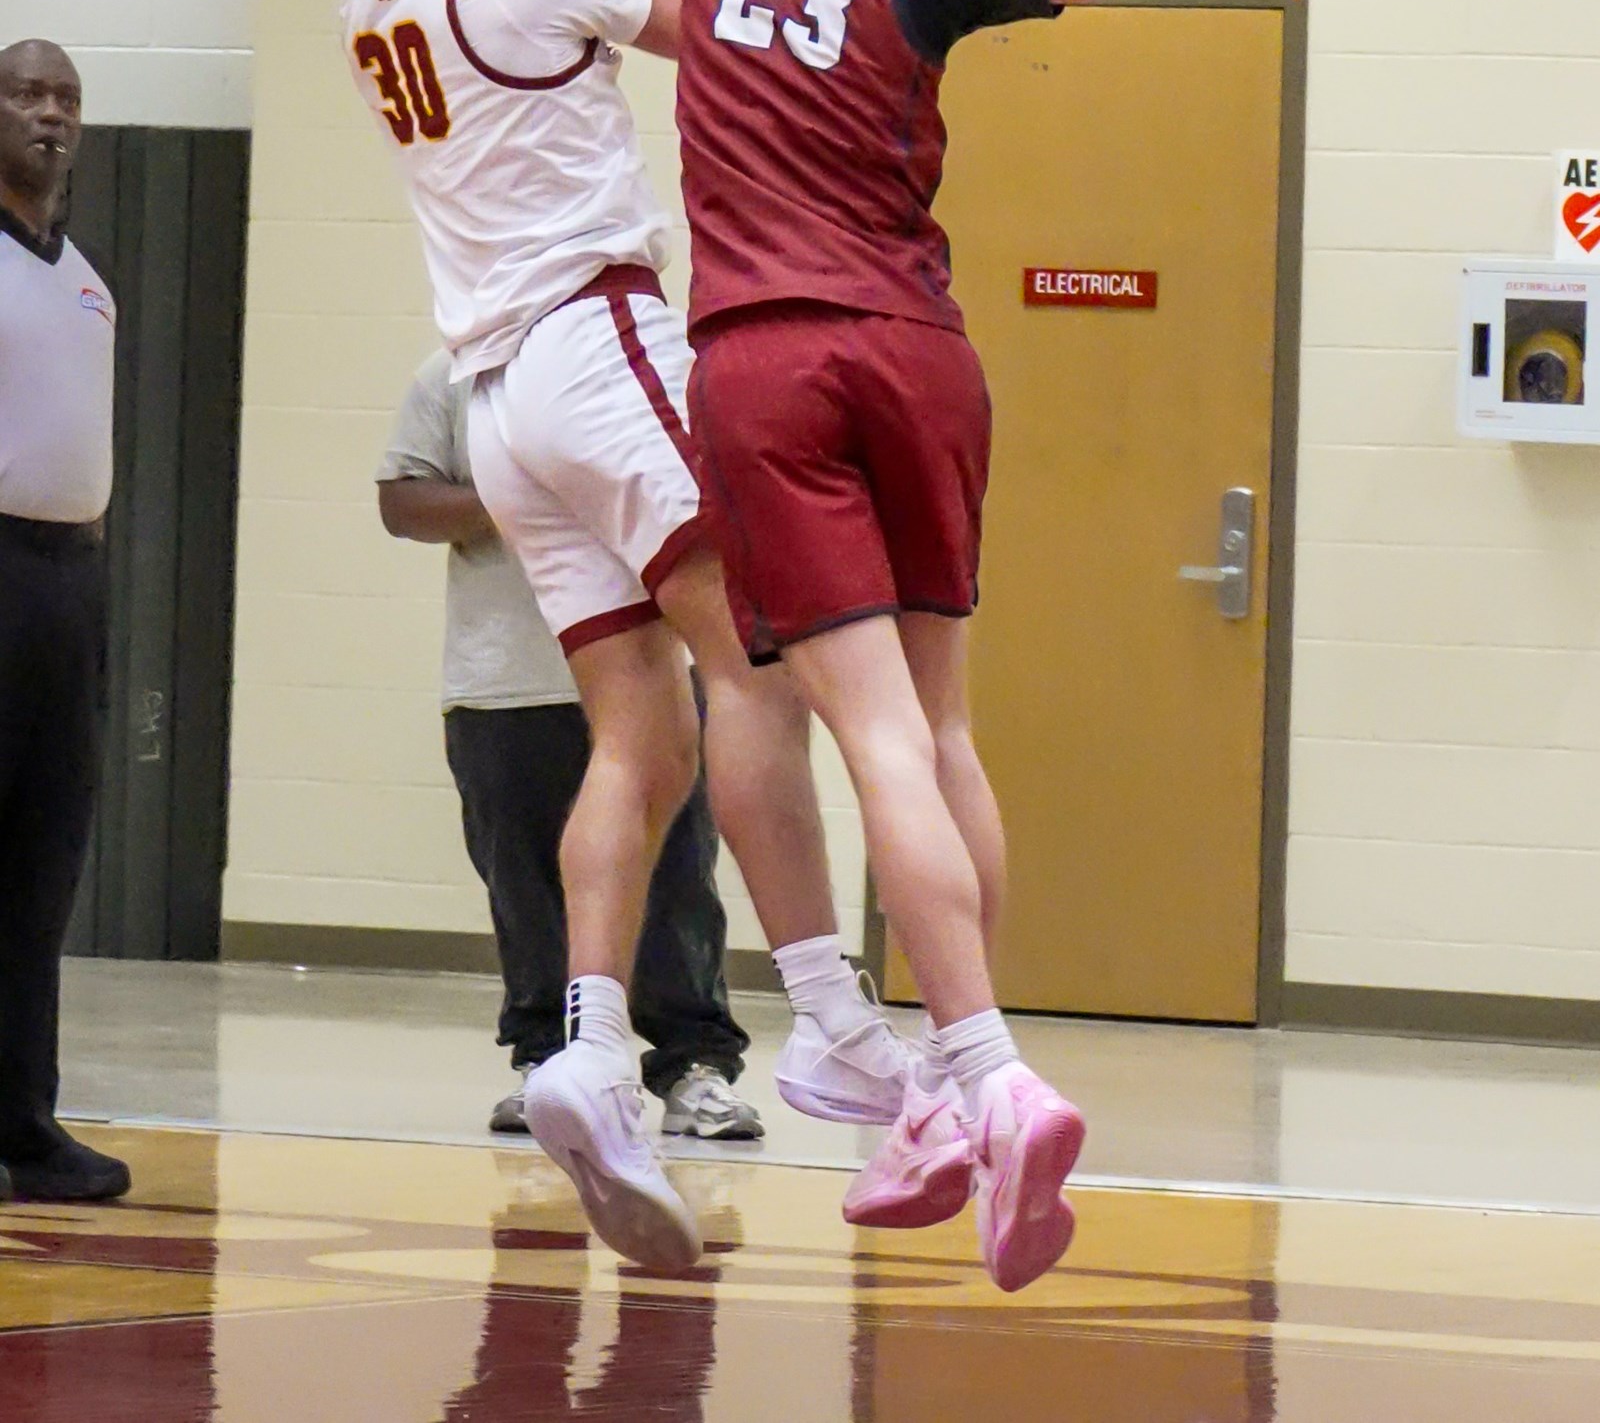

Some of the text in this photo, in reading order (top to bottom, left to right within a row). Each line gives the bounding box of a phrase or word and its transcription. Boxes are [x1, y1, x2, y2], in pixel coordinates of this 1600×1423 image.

[353, 19, 451, 146] 30
[1563, 158, 1598, 187] AE
[1034, 272, 1144, 297] ELECTRICAL
[1504, 281, 1587, 293] DEFIBRILLATOR
